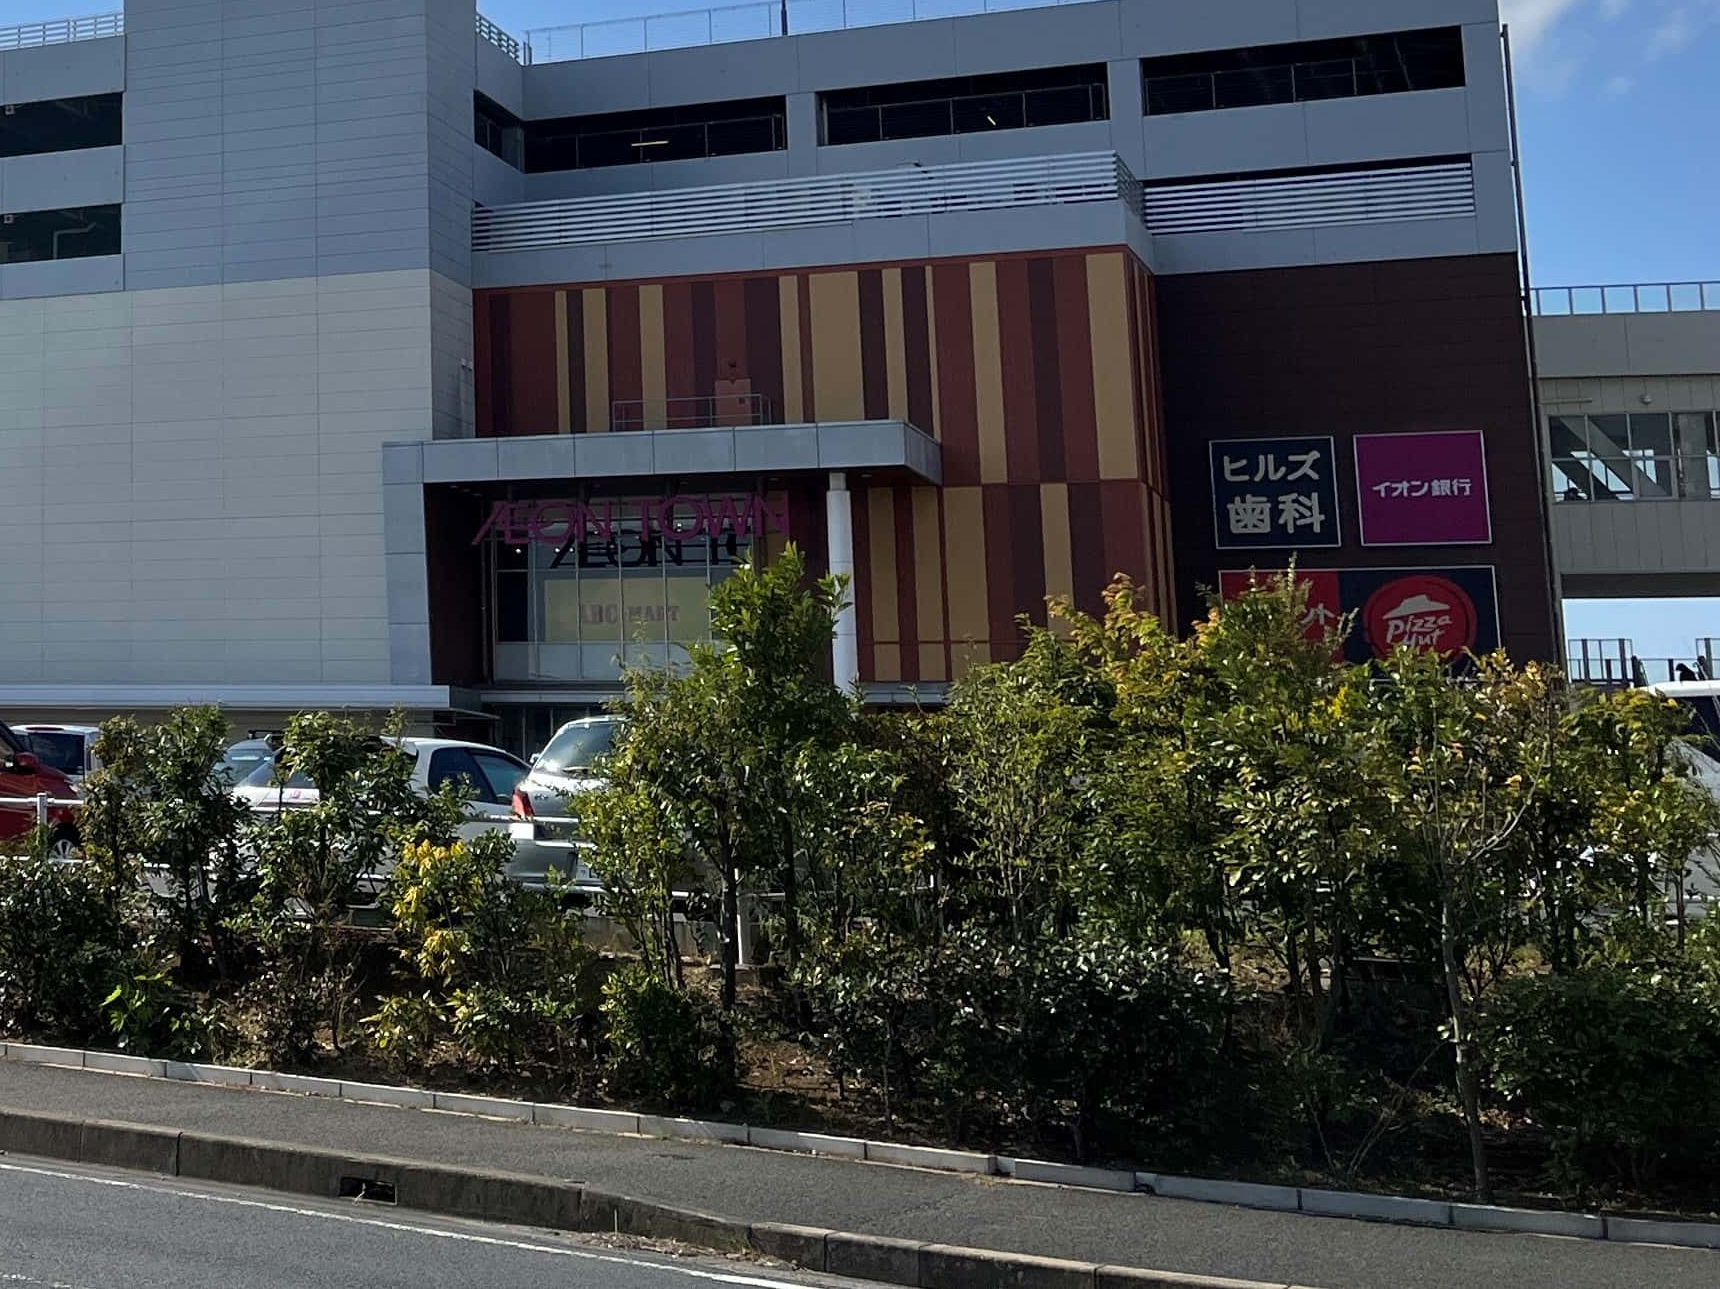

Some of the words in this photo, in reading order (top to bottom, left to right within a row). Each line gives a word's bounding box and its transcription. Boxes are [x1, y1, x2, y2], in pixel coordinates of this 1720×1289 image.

[1223, 450, 1321, 481] ヒルズ
[1372, 478, 1472, 498] イオン銀行
[631, 491, 790, 542] TOWN
[1227, 492, 1325, 534] 歯科
[1386, 614, 1453, 645] Pizza
